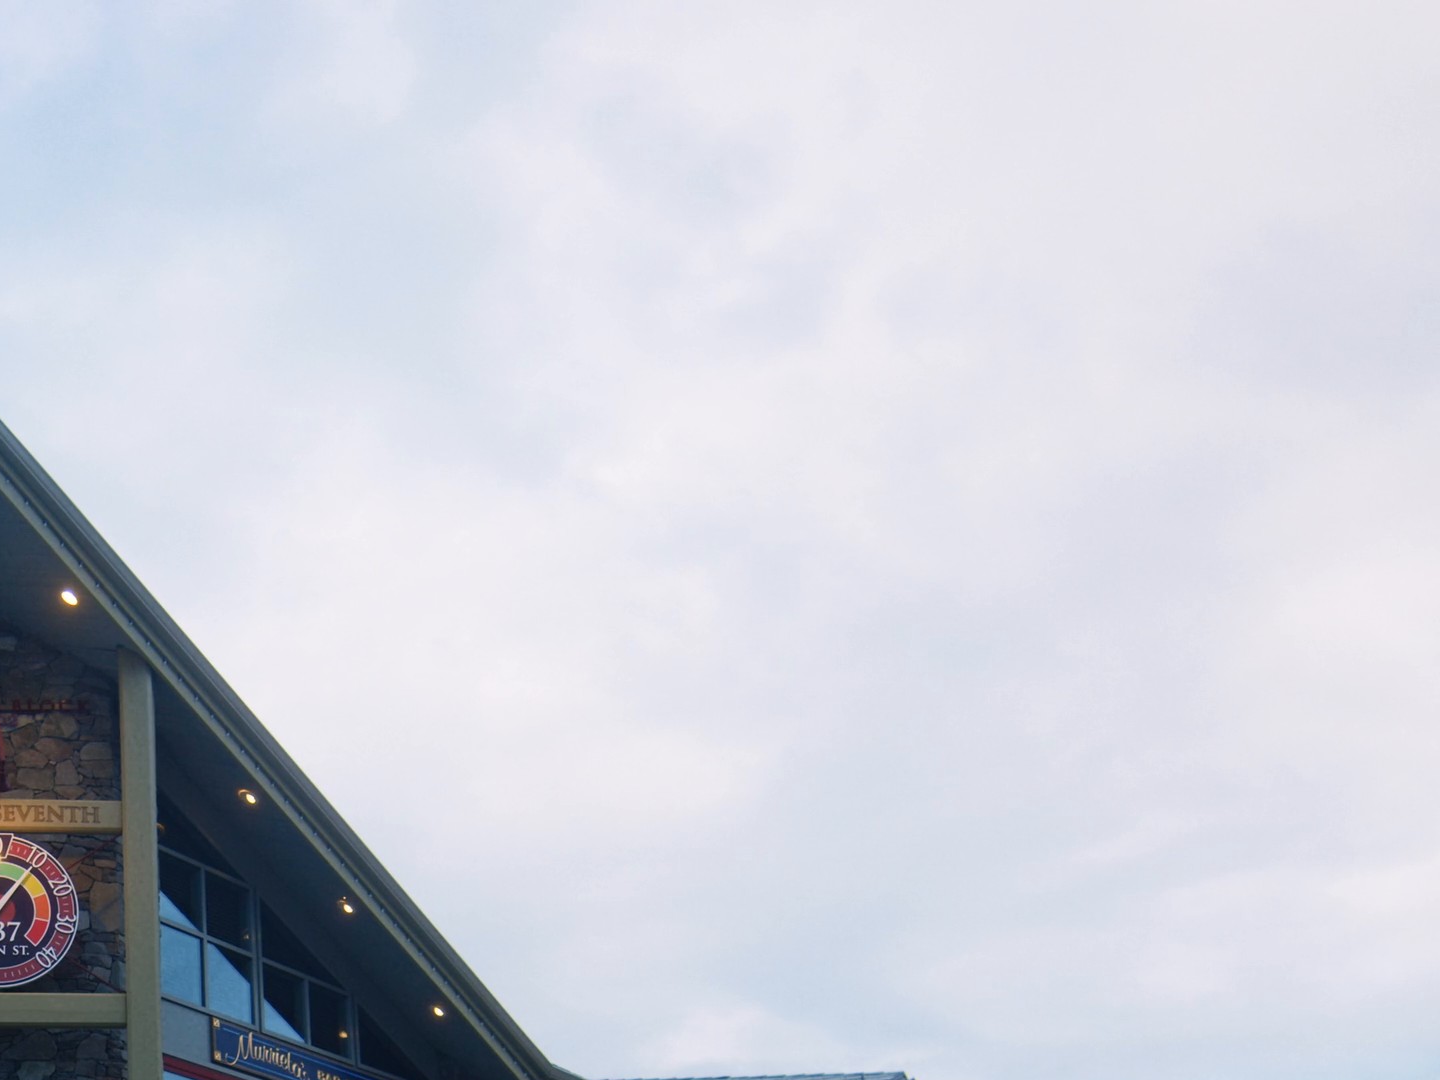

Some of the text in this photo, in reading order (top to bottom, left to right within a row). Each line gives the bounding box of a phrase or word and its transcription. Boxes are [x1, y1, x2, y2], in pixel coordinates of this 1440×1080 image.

[26, 846, 48, 868] 10
[48, 875, 73, 896] 20
[54, 914, 77, 934] 30
[35, 947, 58, 968] 40
